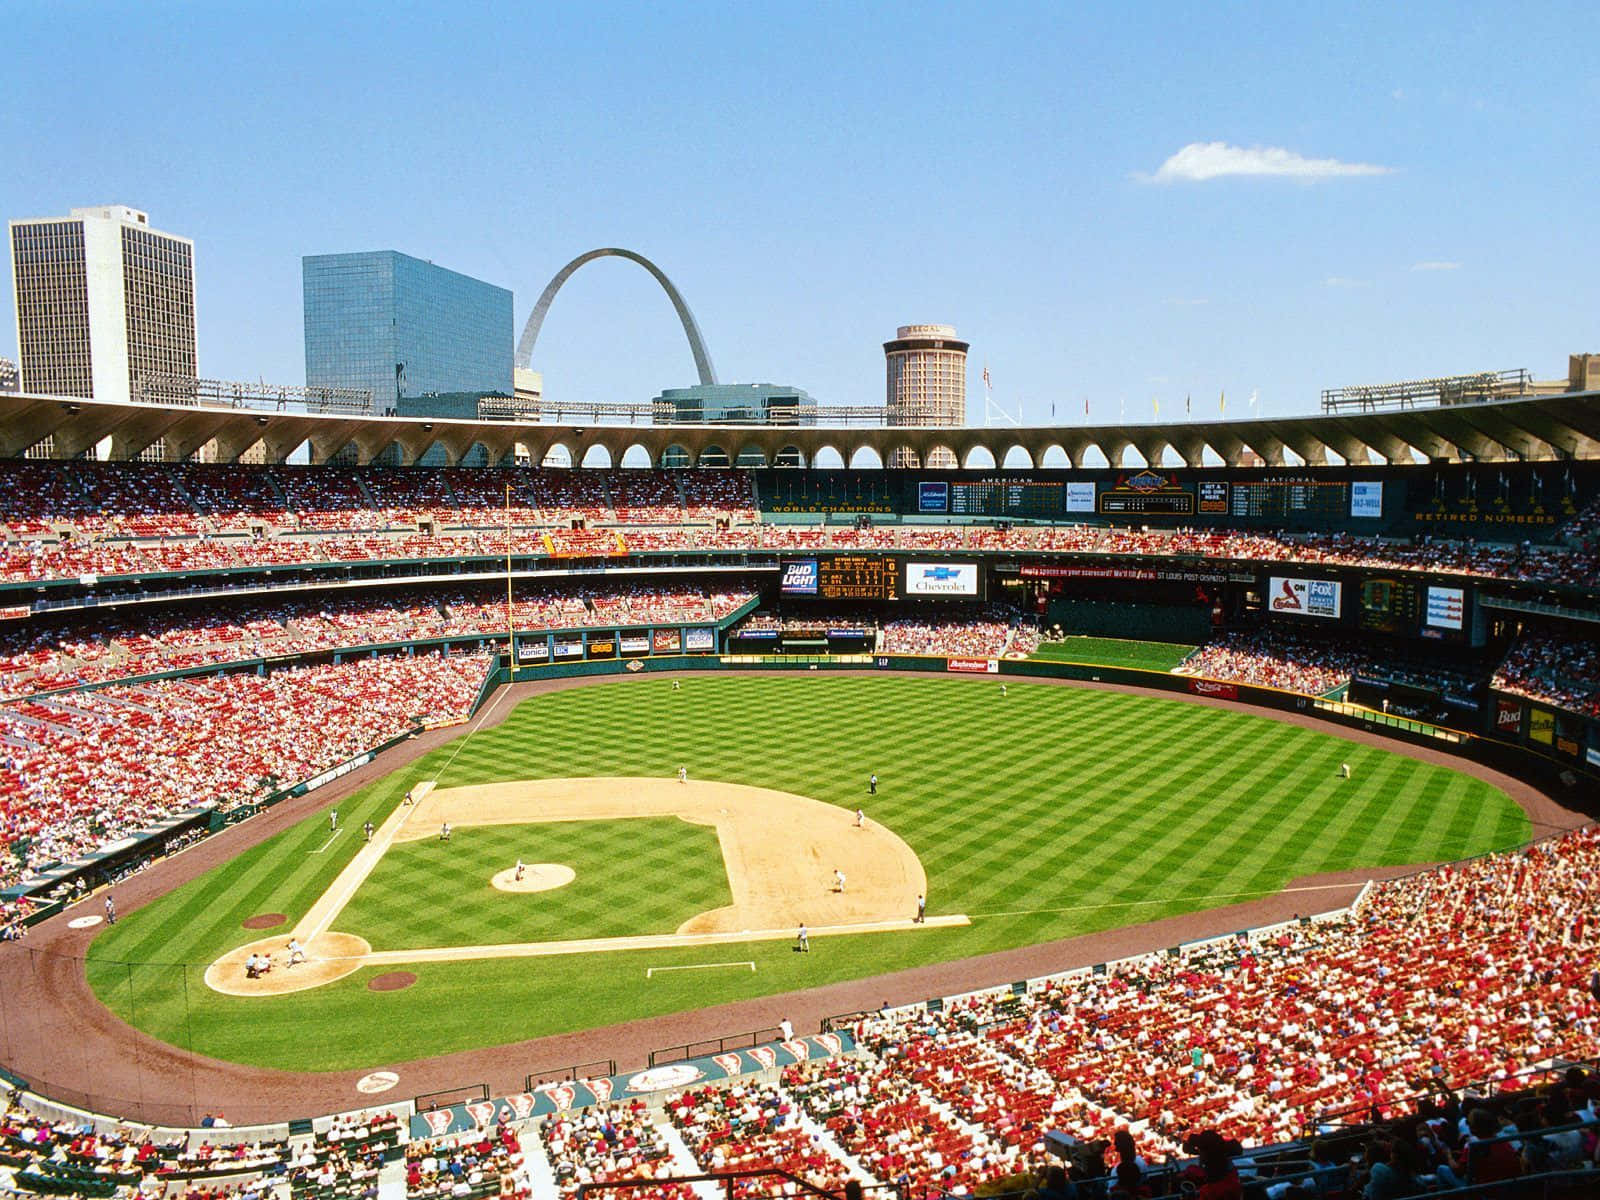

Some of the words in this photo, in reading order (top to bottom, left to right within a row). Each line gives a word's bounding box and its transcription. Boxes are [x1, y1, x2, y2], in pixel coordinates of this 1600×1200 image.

[1415, 513, 1477, 521] RETIRED
[1485, 514, 1555, 524] NUMBERS
[787, 564, 812, 575] BUD
[782, 575, 816, 585] LIGHT
[916, 582, 966, 591] Chevrolet
[1294, 584, 1306, 592] ON
[1311, 583, 1331, 596] FOX
[688, 633, 711, 642] BUSCH
[520, 648, 547, 657] Konica
[950, 660, 986, 668] Budweiser
[1497, 709, 1520, 724] Bud
